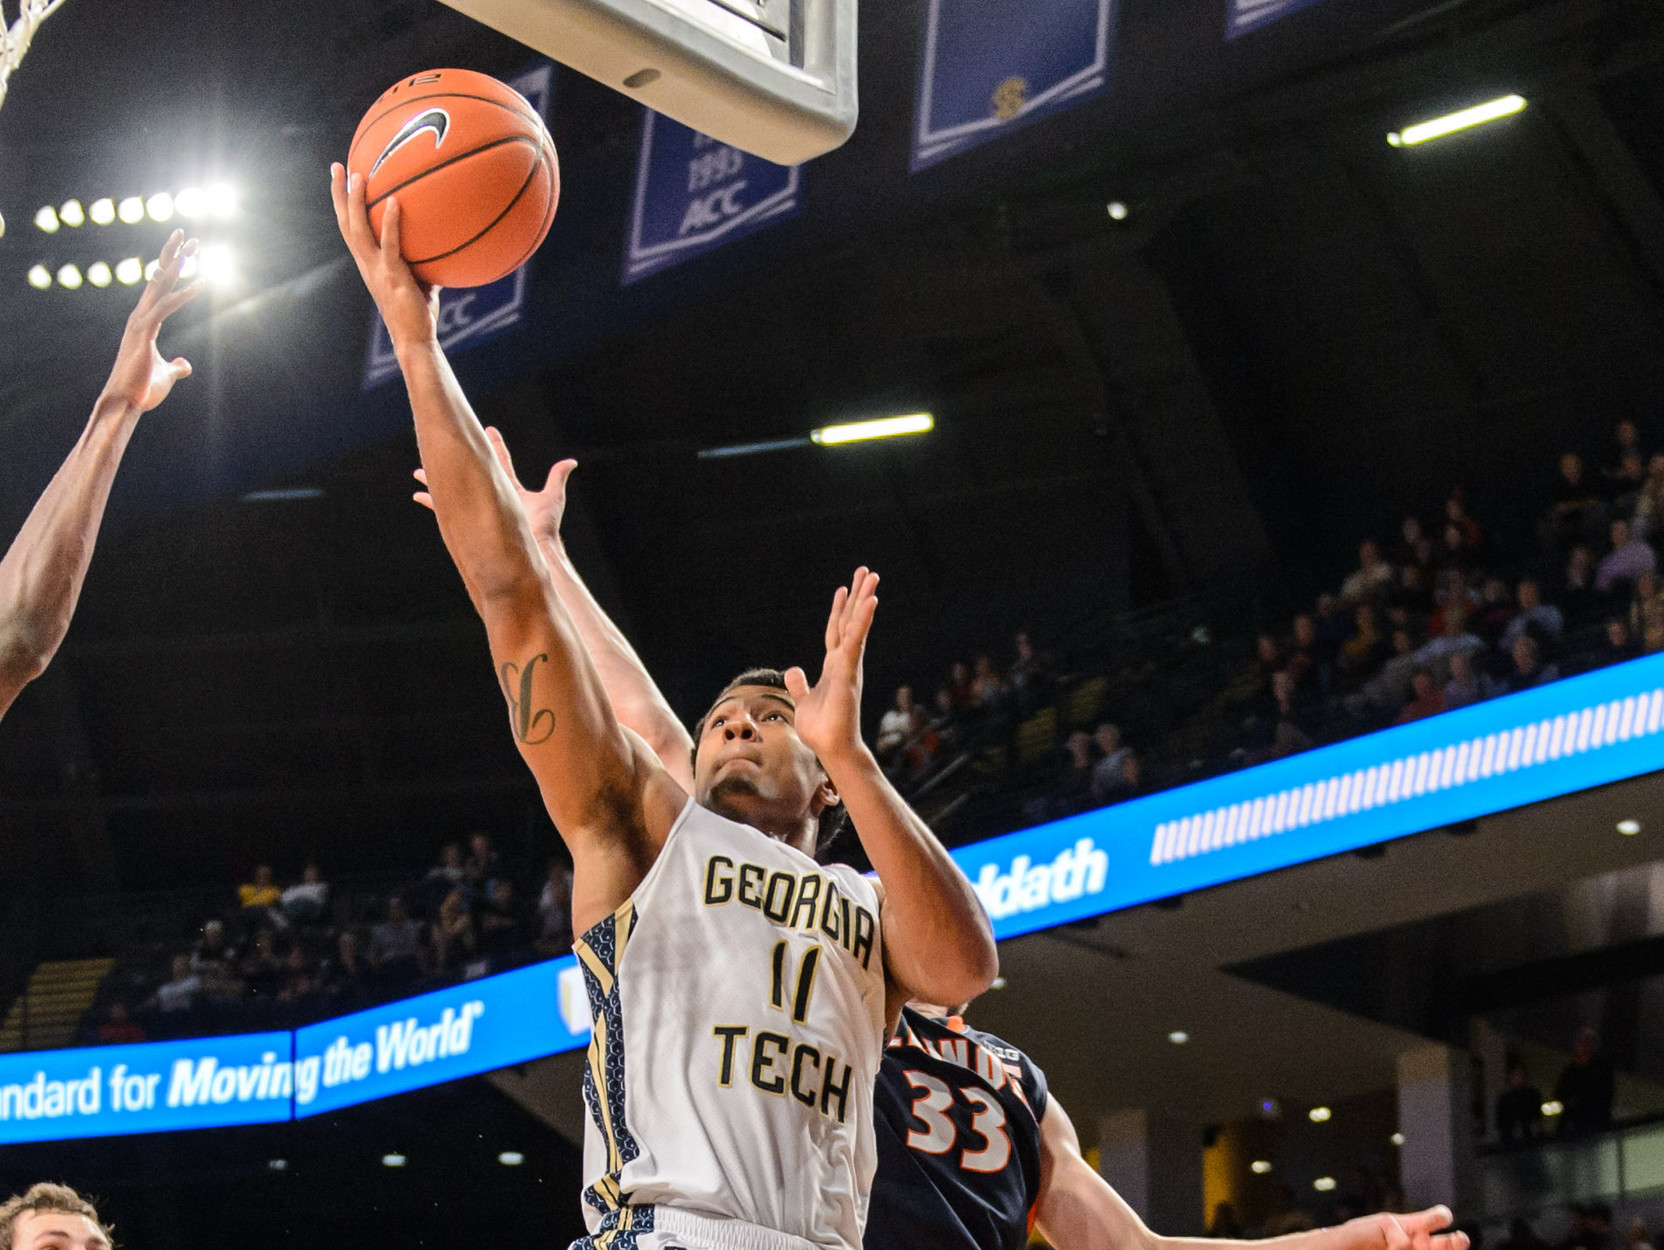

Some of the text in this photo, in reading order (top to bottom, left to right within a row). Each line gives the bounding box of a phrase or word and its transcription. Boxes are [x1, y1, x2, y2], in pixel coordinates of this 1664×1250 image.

[678, 180, 748, 236] ACC
[438, 292, 476, 334] CC
[702, 854, 876, 972] GEORGIA
[769, 938, 823, 1026] 11
[0, 1066, 103, 1121] ndard
[109, 1063, 162, 1113] for
[166, 1051, 322, 1108] Moving
[322, 1035, 373, 1088] the
[712, 1023, 852, 1126] TECH
[902, 1069, 1012, 1174] 33
